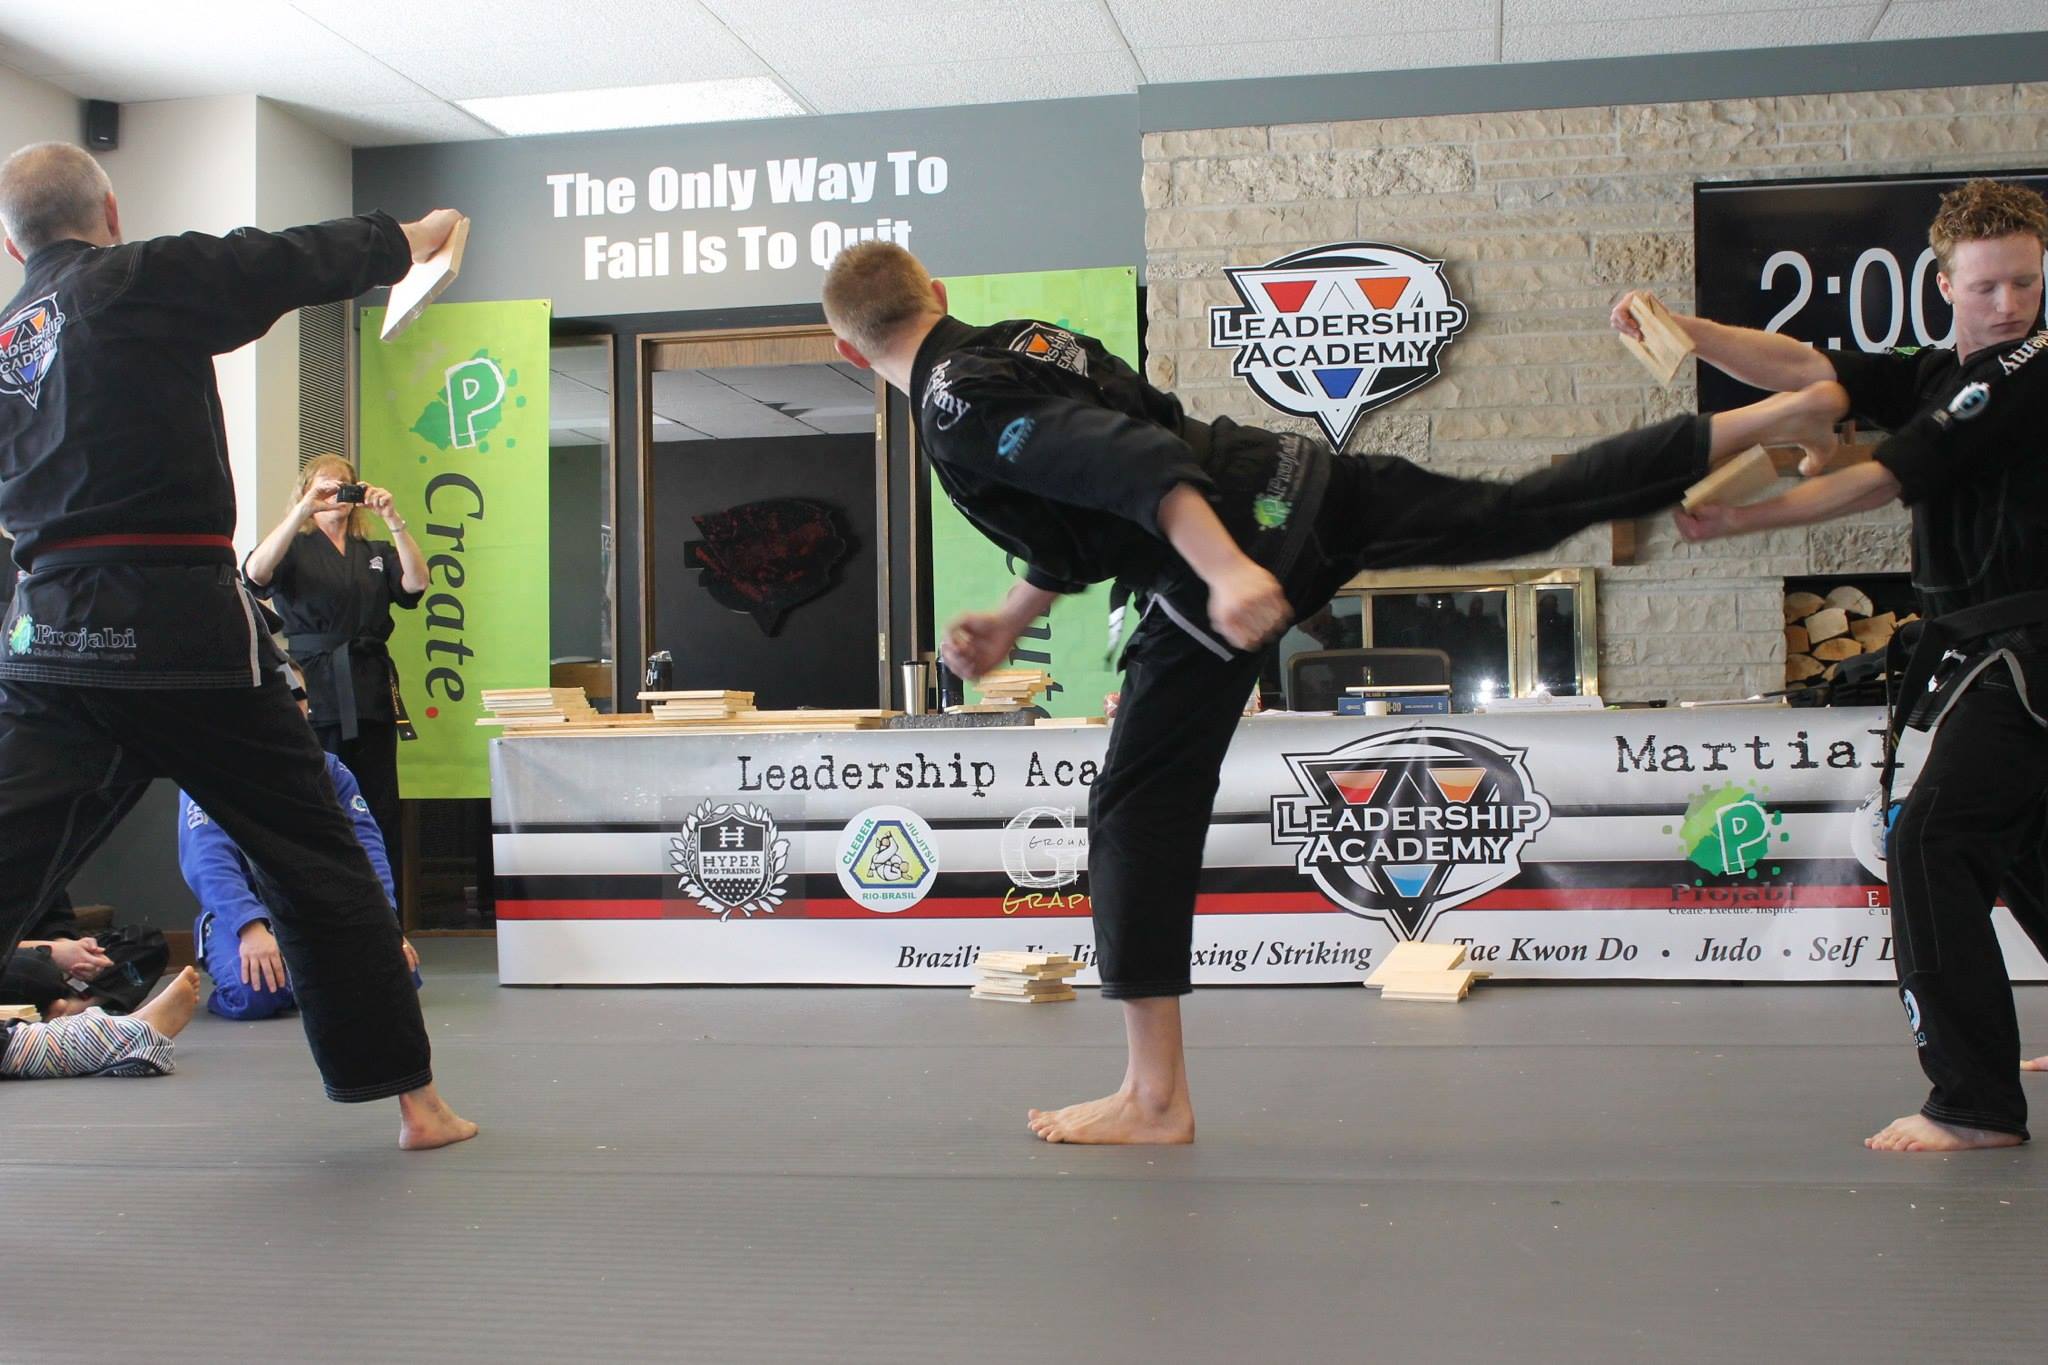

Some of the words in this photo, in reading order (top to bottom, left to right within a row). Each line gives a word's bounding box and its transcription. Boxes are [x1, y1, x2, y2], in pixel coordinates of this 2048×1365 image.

[547, 172, 636, 219] The
[648, 163, 757, 212] Only
[766, 157, 877, 204] Way
[887, 150, 948, 196] To
[584, 232, 669, 281] Fail
[682, 229, 727, 275] Is
[738, 225, 797, 271] To
[1217, 310, 1459, 342] LEADERSHIP
[1243, 340, 1432, 368] ACADEMY
[33, 624, 137, 653] Projabi
[738, 752, 996, 798] Leadership
[1025, 752, 1098, 787] Aca
[1278, 804, 1538, 835] LEADERSHIP
[842, 818, 875, 865] CLEBER
[1309, 834, 1507, 863] ACADEMY
[703, 855, 761, 867] HYPER
[1002, 886, 1092, 915] GRAP
[1670, 881, 1797, 906] Projabi
[1191, 940, 1373, 972] xing/Striking
[1507, 937, 1588, 962] Kwon
[1596, 937, 1639, 962] Do
[1695, 937, 1762, 962] Judo
[1808, 936, 1869, 968] Self
